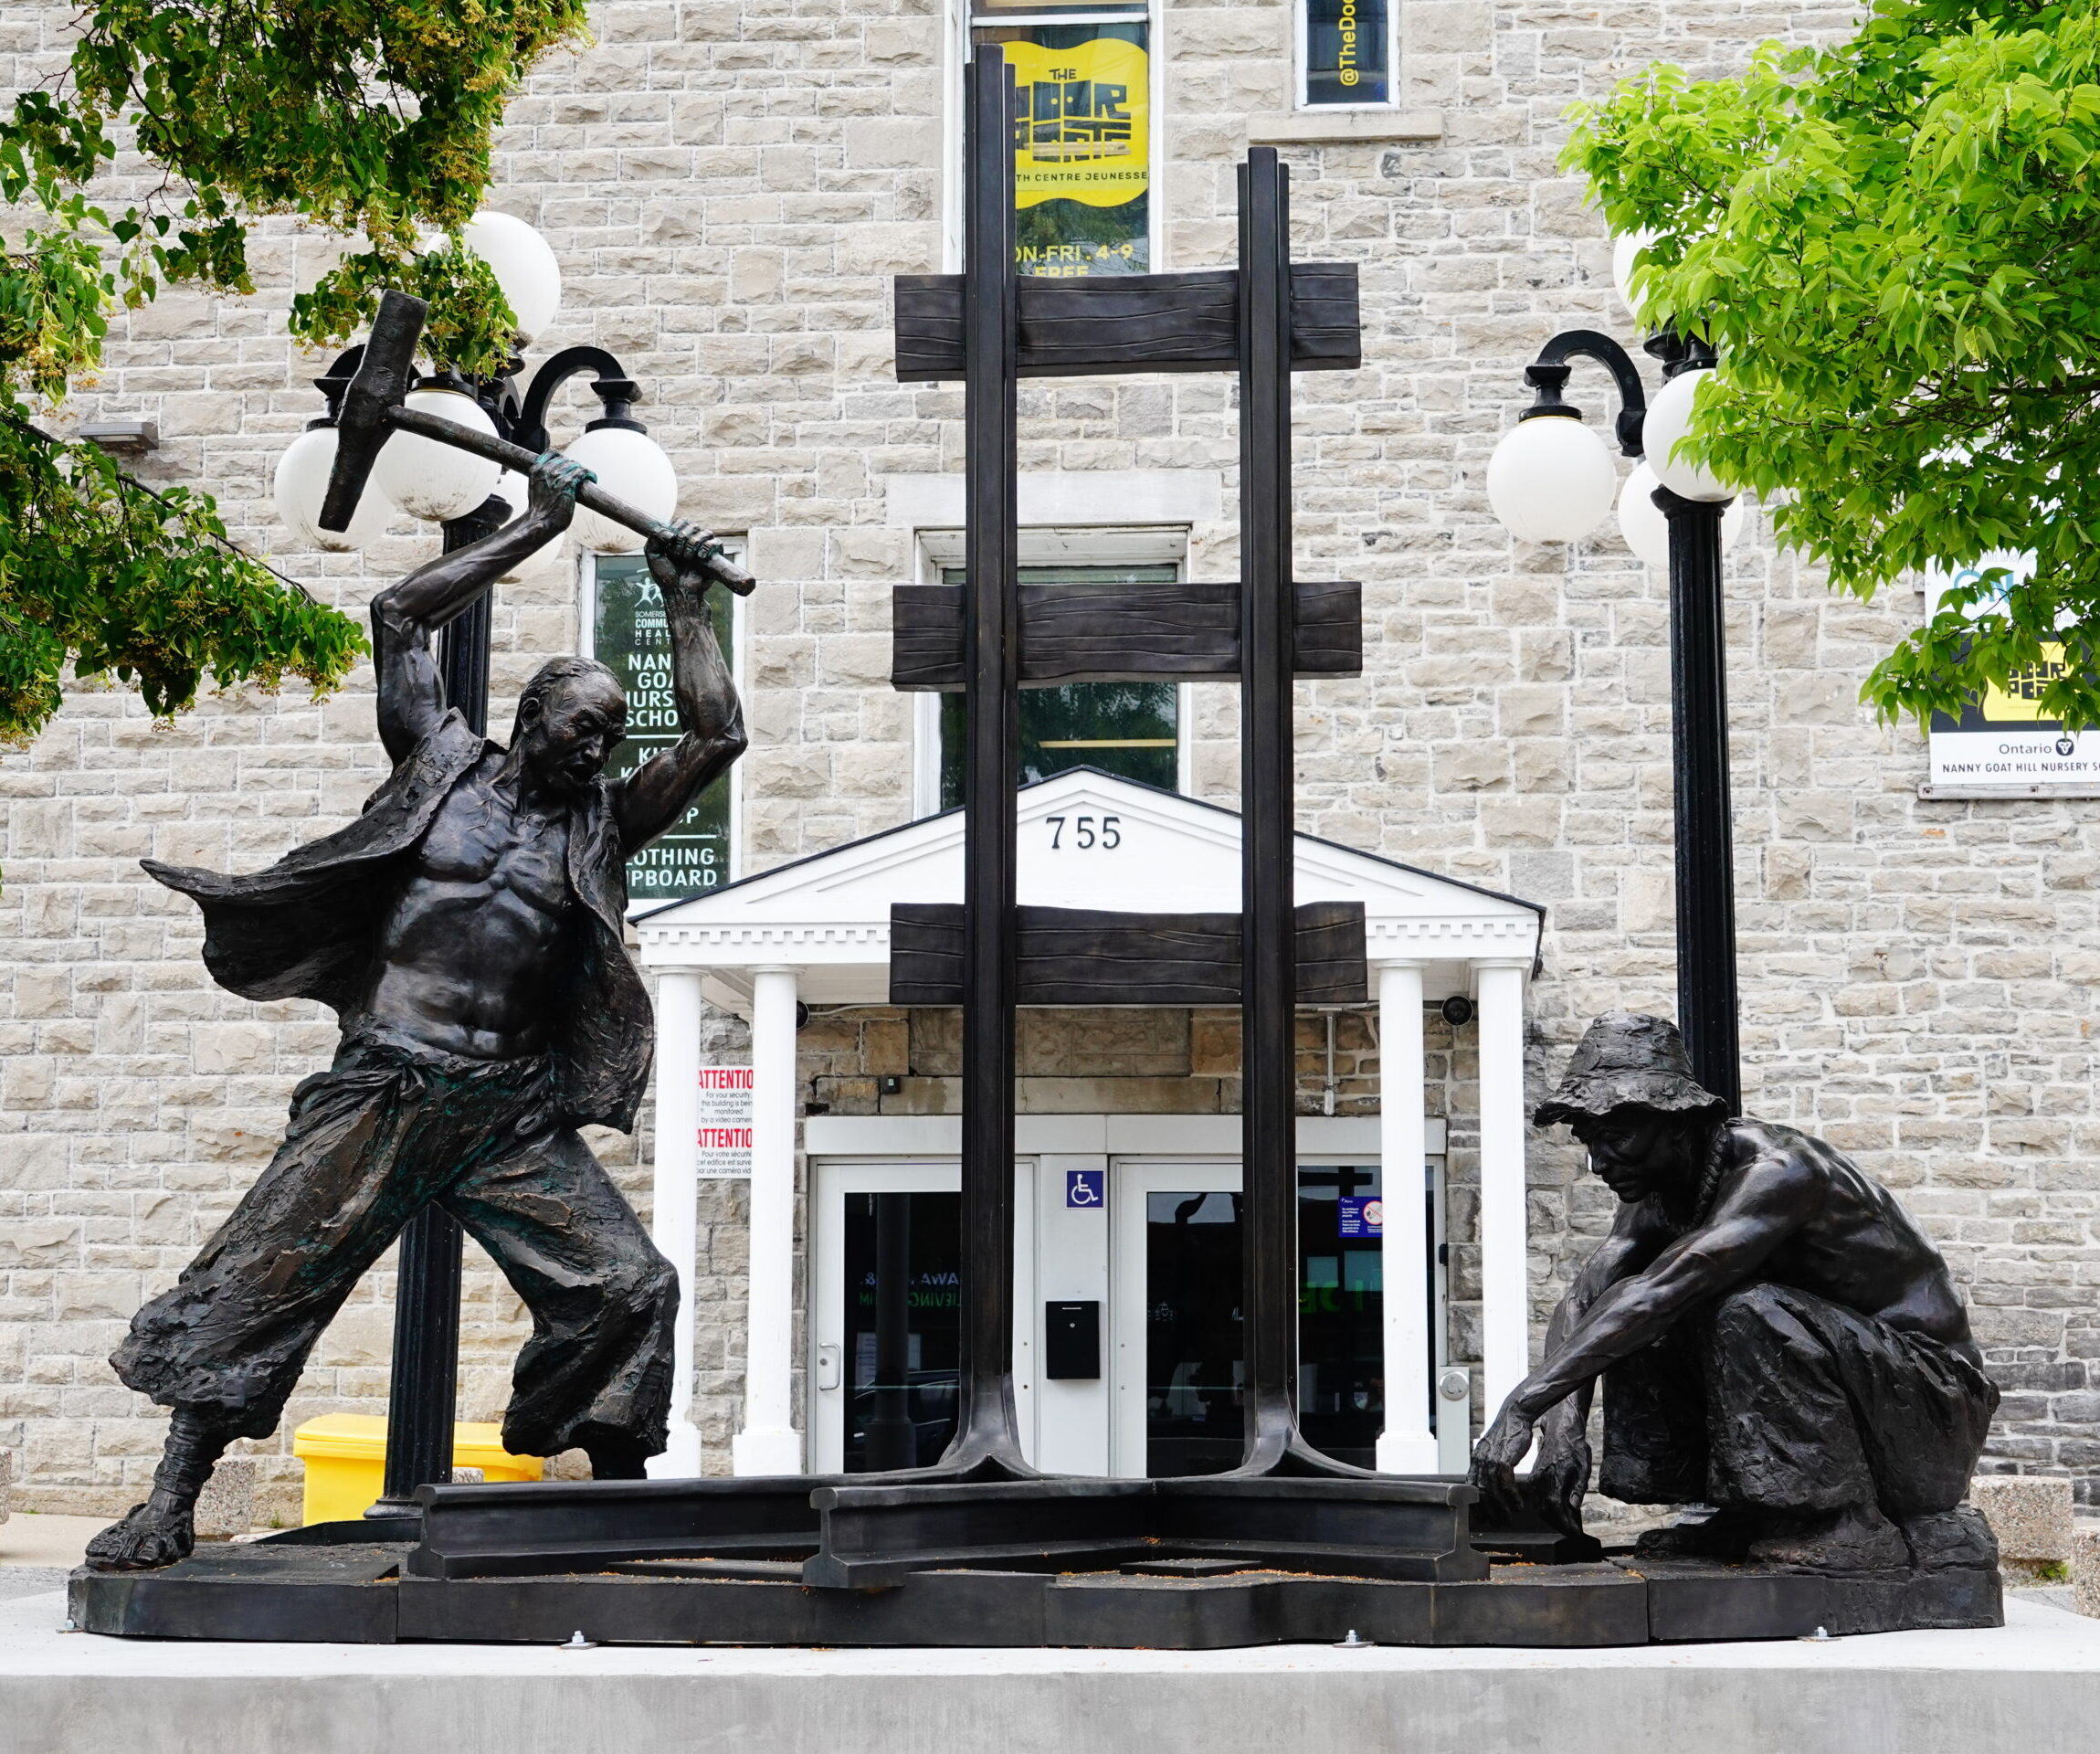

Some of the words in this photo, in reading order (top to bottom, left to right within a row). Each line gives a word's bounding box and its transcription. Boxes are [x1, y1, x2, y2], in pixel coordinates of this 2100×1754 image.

[1339, 0, 1359, 86] @TheDo
[1049, 69, 1077, 80] THE
[1035, 173, 1082, 182] CENTRE
[1085, 171, 1148, 181] JEUNESSE
[635, 618, 669, 629] COMMU
[635, 629, 671, 638] HEAL
[628, 653, 671, 671] NAN
[638, 671, 674, 689] GO
[625, 709, 679, 727] SCHO
[1999, 743, 2053, 755] Ontario
[1943, 764, 1981, 773] NANNY
[1985, 763, 2012, 772] GOAT
[2016, 762, 2037, 772] HILL
[2041, 762, 2088, 771] NURSERY
[1046, 817, 1121, 850] 755
[626, 848, 714, 866] OTHING
[627, 869, 717, 887] PBOARD
[699, 1069, 754, 1089] ATTENTIO
[698, 1128, 753, 1147] ATTENTIO
